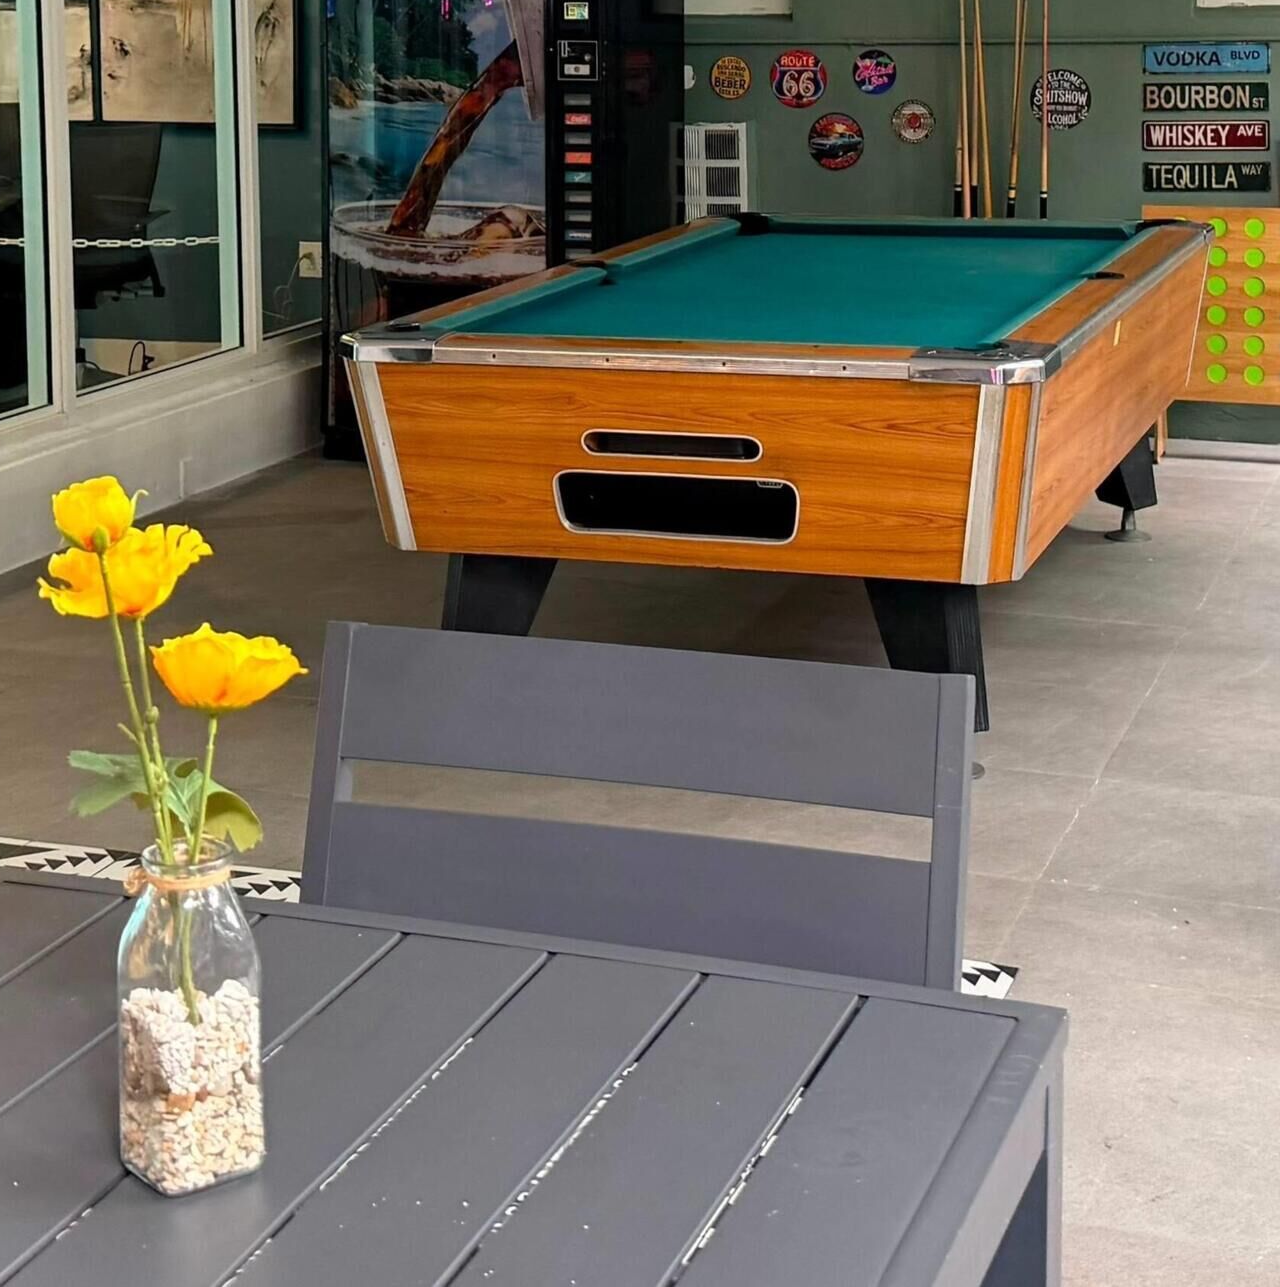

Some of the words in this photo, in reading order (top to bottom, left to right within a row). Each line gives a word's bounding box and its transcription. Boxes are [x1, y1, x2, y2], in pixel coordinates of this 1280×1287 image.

[780, 55, 816, 67] ROUTE
[1153, 51, 1221, 67] VODKA
[1230, 50, 1260, 60] BLVD
[714, 76, 746, 90] BEBER
[782, 70, 816, 97] 66
[1044, 70, 1083, 88] ELCOME
[1146, 85, 1250, 109] BOURBON
[1252, 98, 1265, 108] ST
[1047, 112, 1078, 125] LCOHOL
[1149, 125, 1230, 146] WHISKEY
[1237, 125, 1264, 136] AVE
[1148, 164, 1239, 189] TEQUILA
[1241, 164, 1263, 175] WAY
